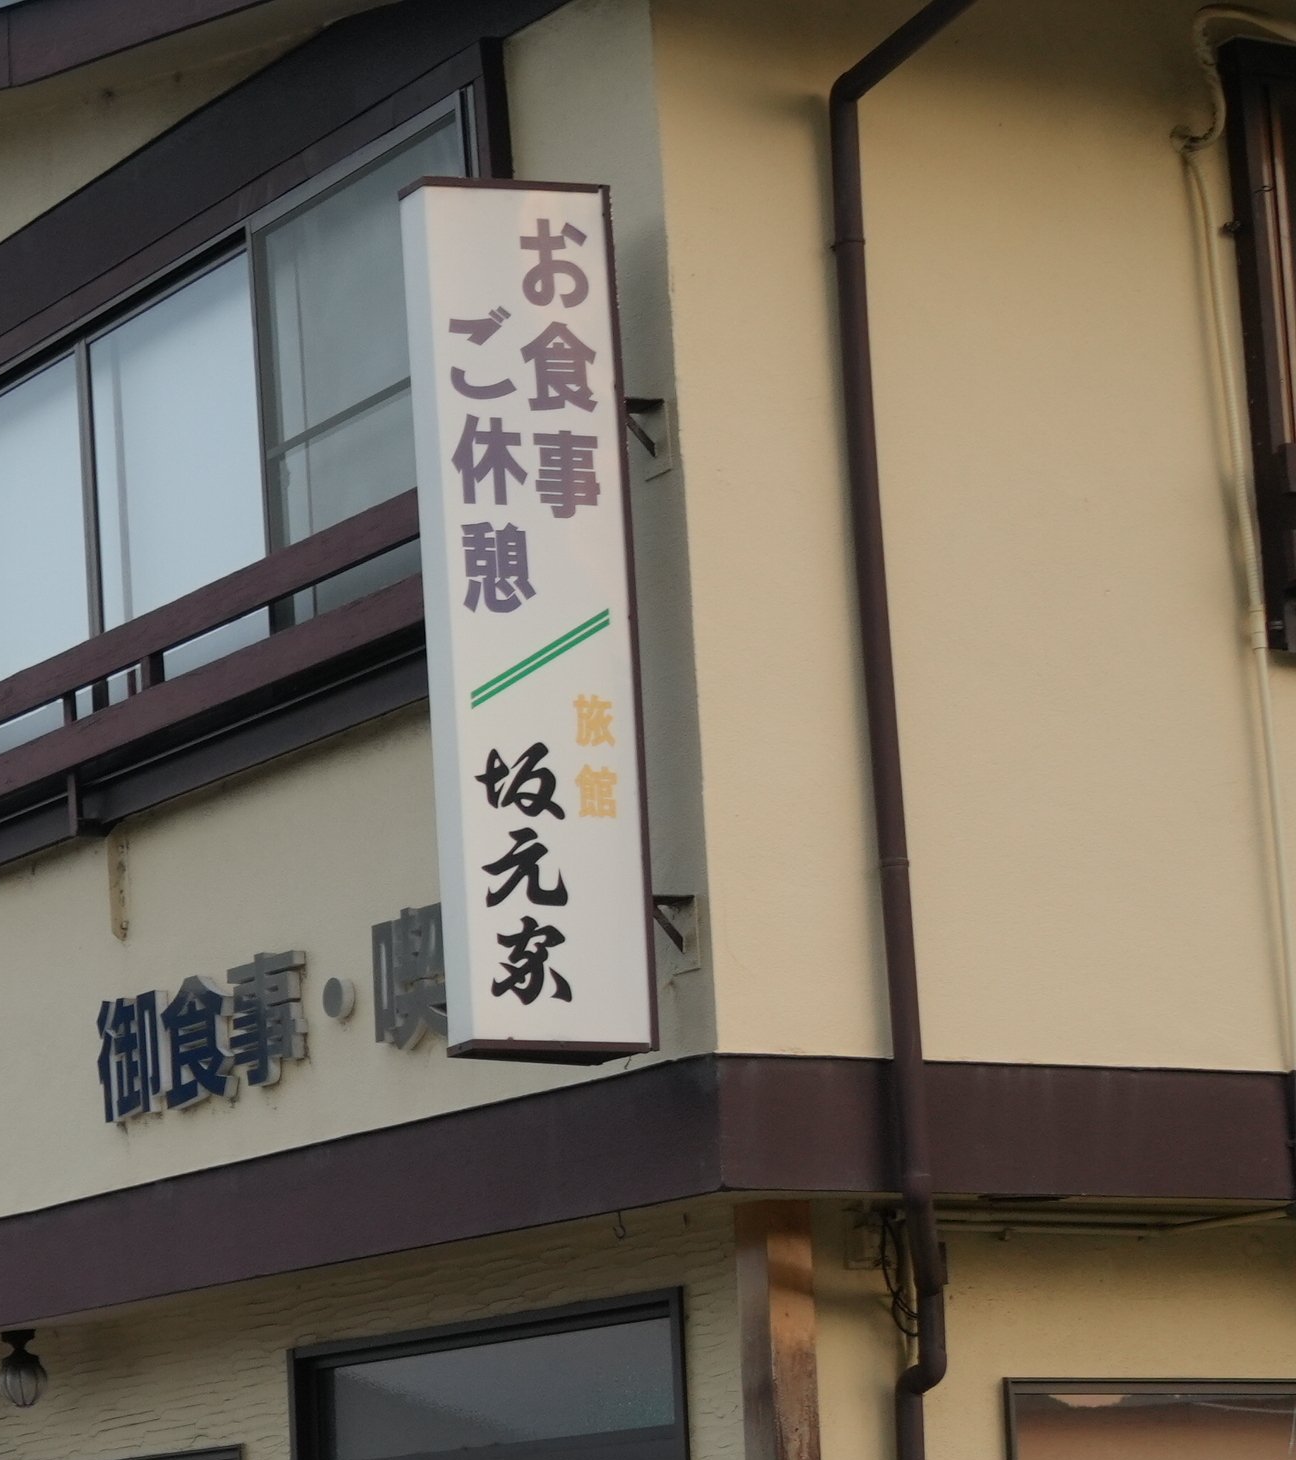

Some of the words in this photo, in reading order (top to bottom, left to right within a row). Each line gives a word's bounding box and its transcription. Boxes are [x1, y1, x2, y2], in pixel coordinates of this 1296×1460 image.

[447, 304, 536, 614] ご休憩
[519, 217, 602, 520] お食事
[573, 693, 618, 822] 旅館
